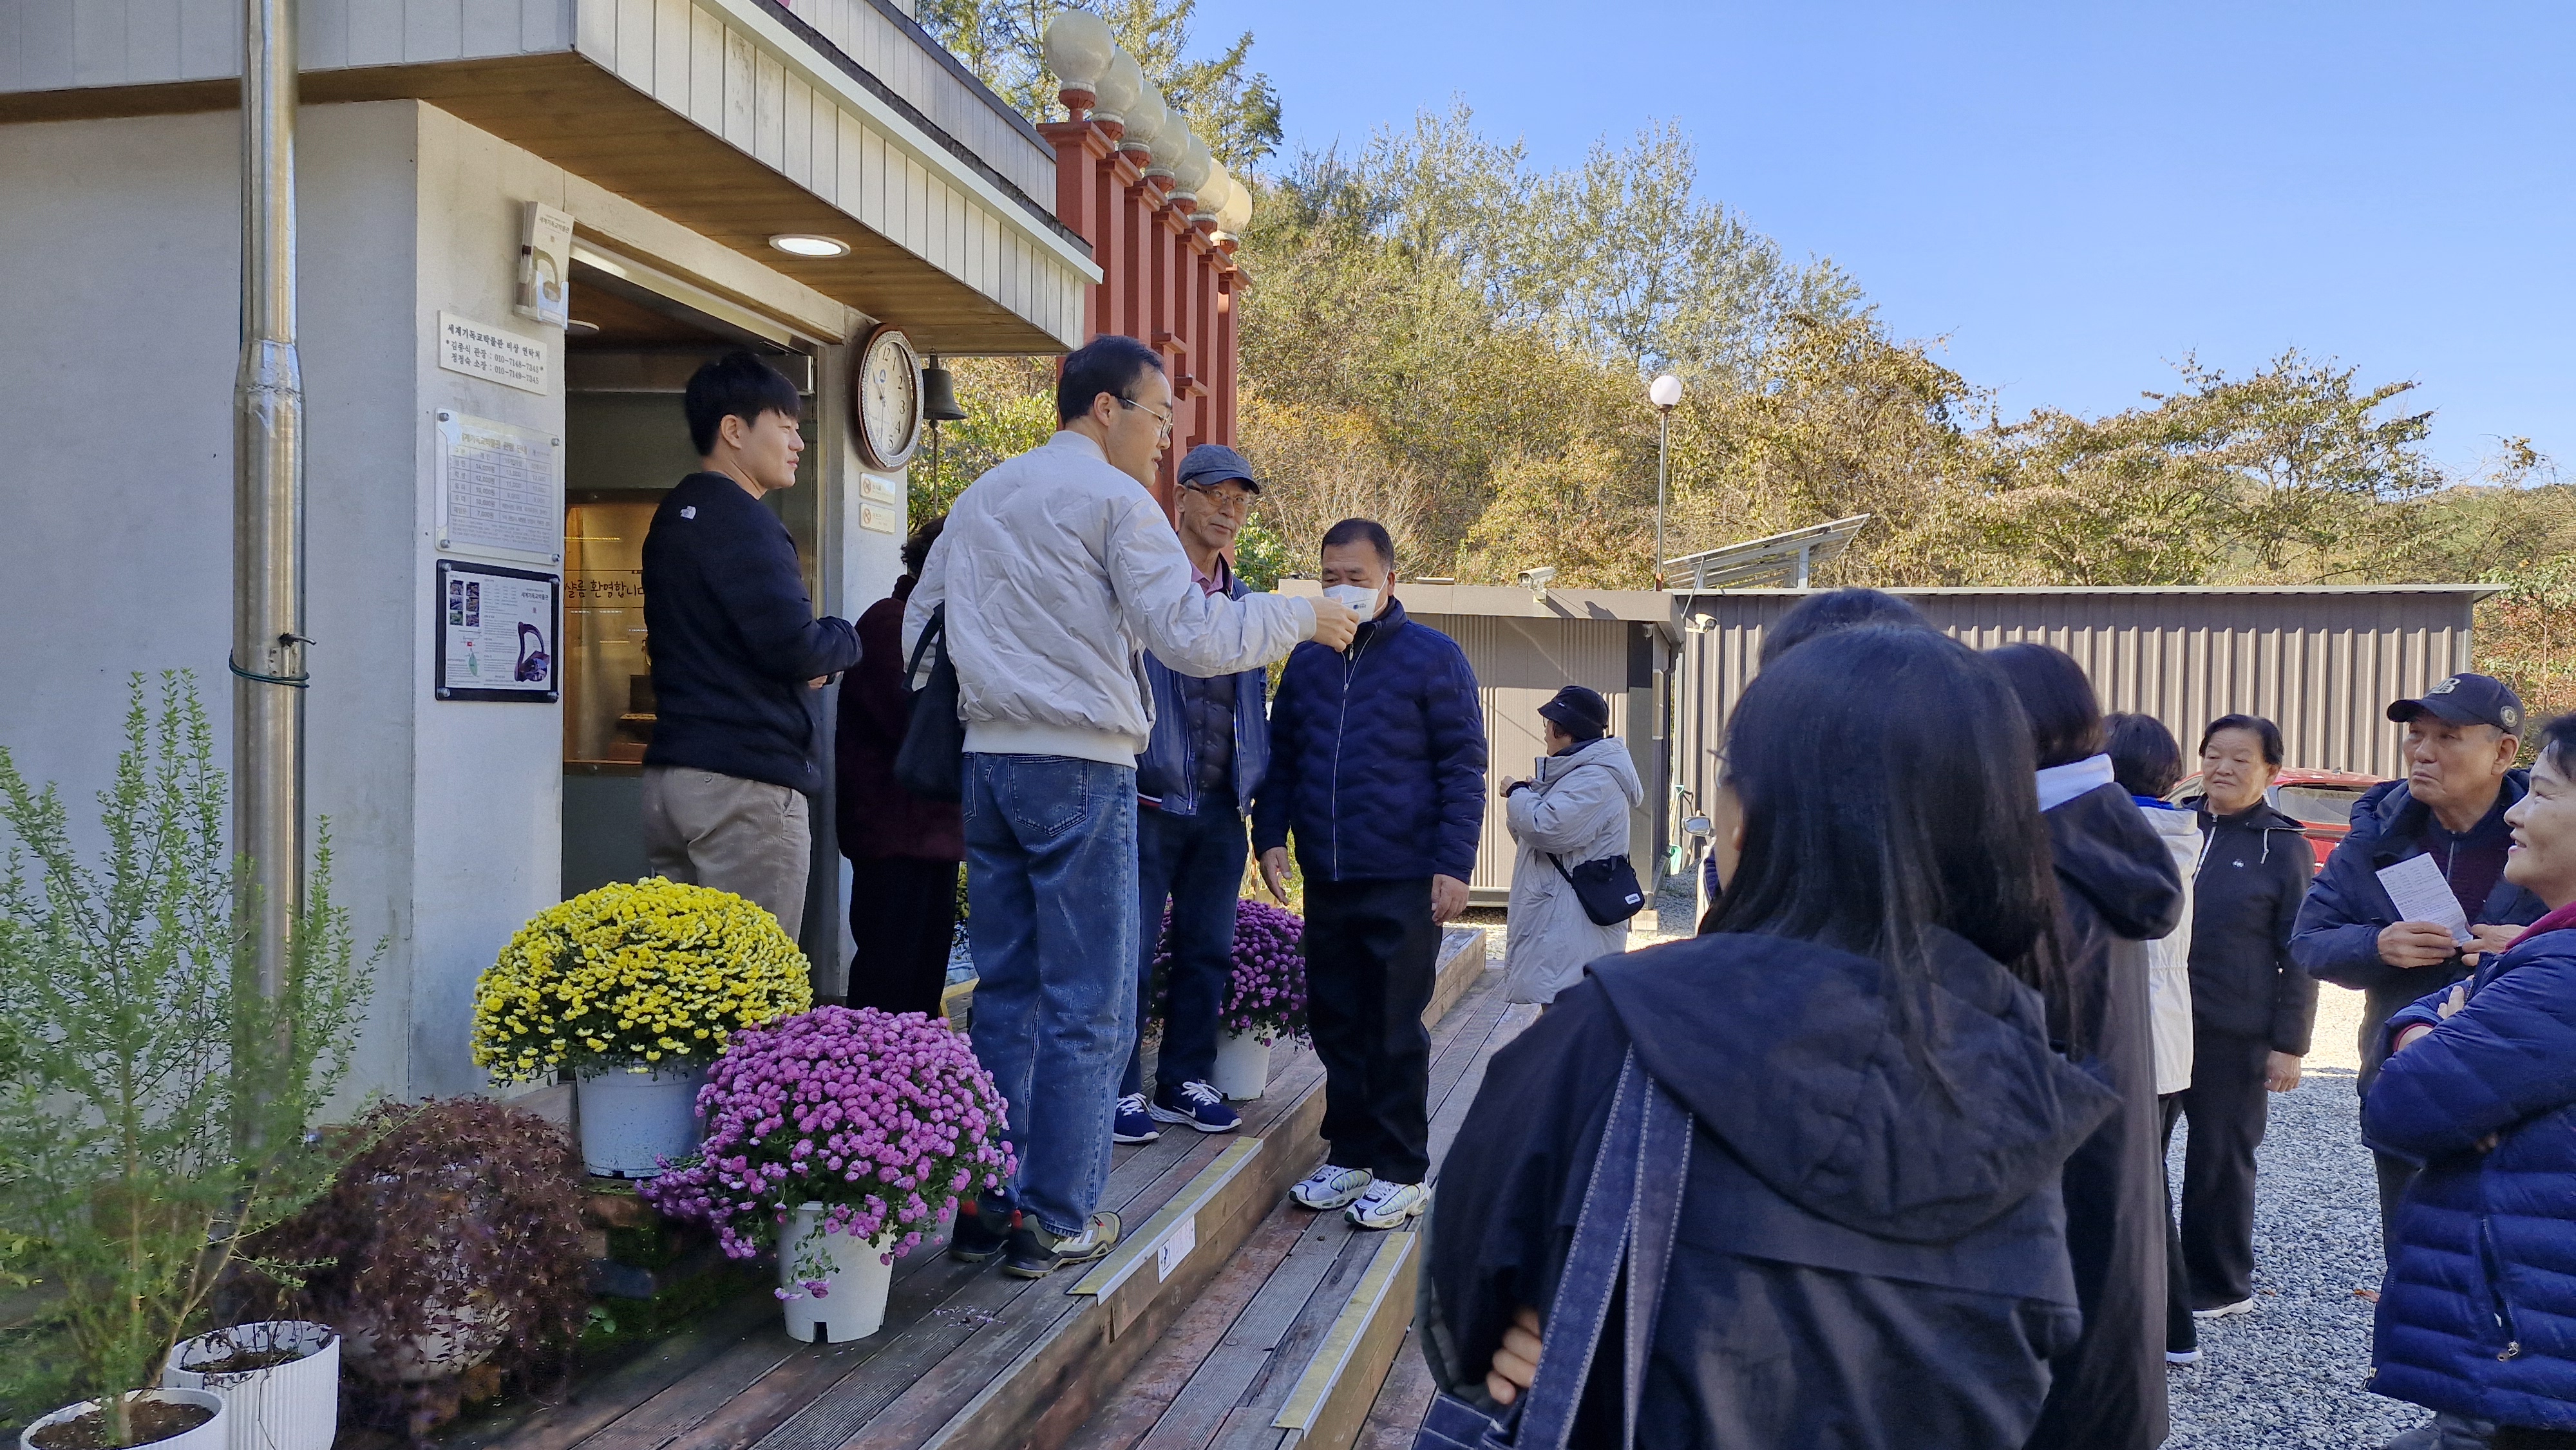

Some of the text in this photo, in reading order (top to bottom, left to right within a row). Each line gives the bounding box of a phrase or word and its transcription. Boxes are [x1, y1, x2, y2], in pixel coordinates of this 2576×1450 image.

[448, 324, 541, 361] 세계기독교박물관 비상 연락처
[474, 347, 488, 360] 관장
[494, 353, 539, 373] 010-7148-7345
[882, 346, 891, 362] 12
[474, 359, 488, 372] 소장
[892, 357, 896, 372] 1
[898, 375, 903, 390] 2
[899, 400, 905, 415] 3
[895, 420, 901, 434] 4
[888, 434, 894, 449] 5
